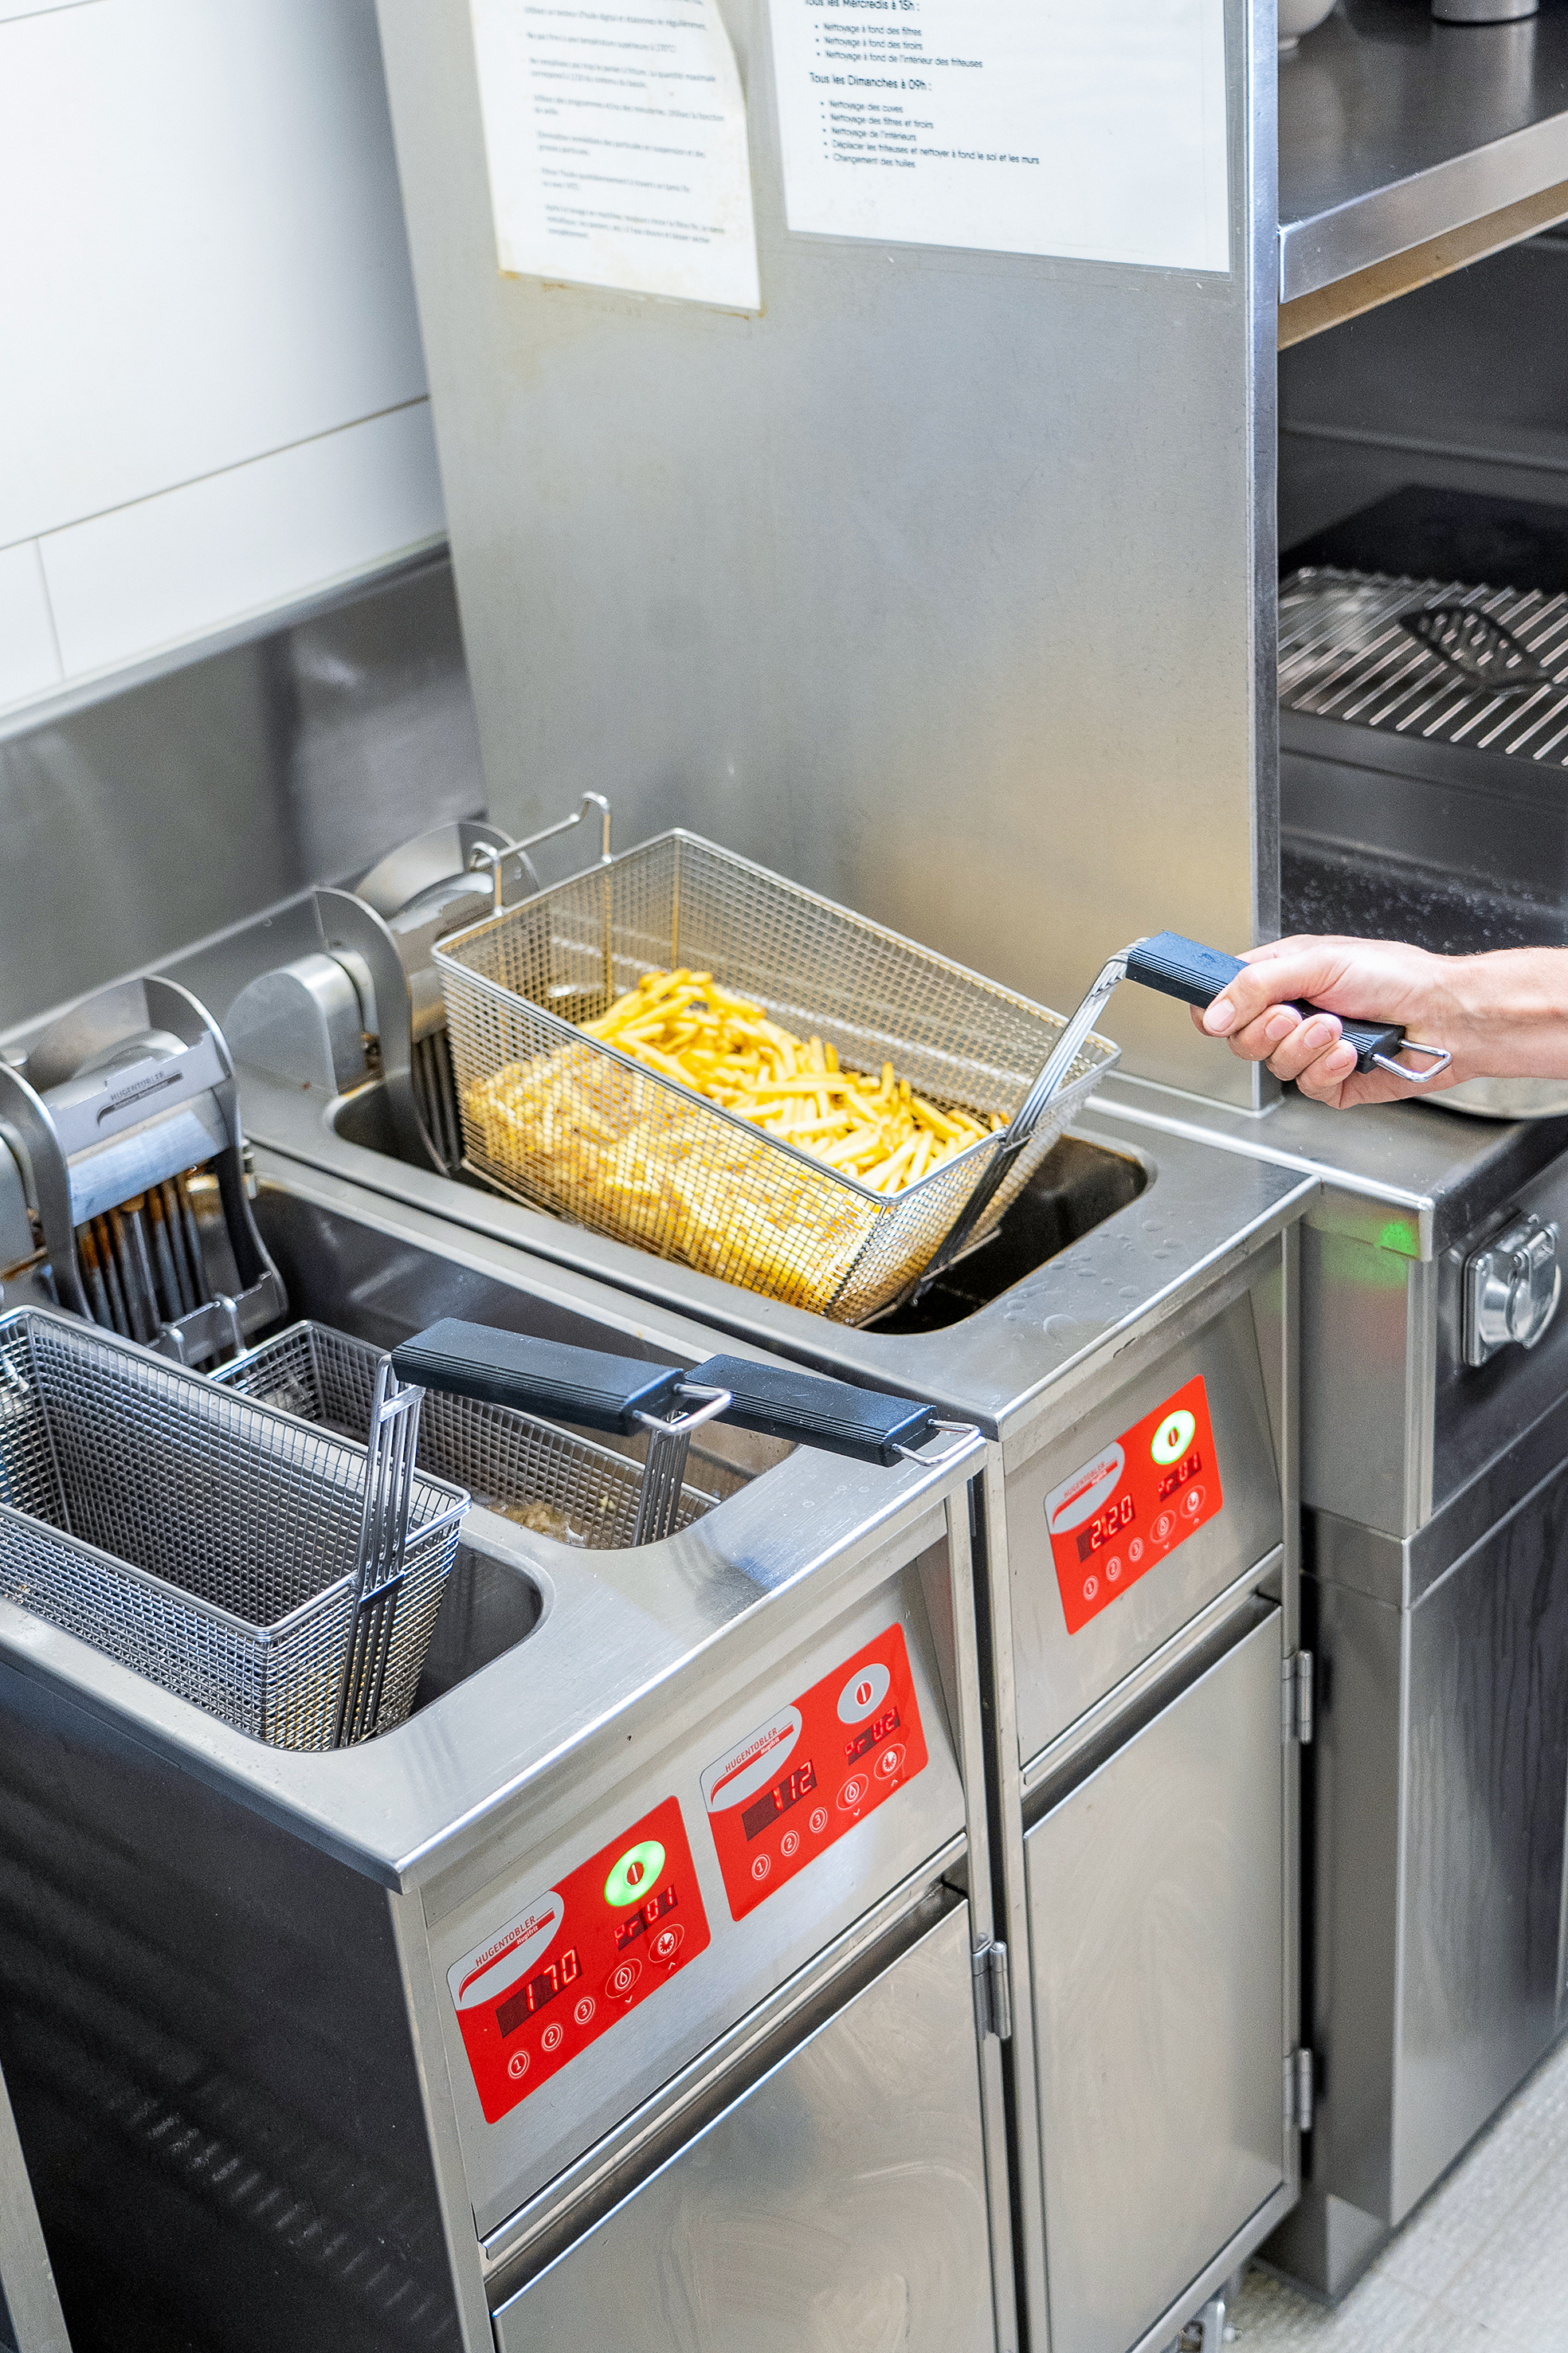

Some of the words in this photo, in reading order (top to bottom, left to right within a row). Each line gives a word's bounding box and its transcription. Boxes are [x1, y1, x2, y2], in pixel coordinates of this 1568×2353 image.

[824, 23, 860, 35] Nettoyage
[868, 25, 884, 34] fond
[888, 25, 900, 35] des
[903, 26, 922, 37] filtres
[824, 37, 860, 49] Nettoyage
[869, 38, 885, 48] fond
[888, 40, 900, 49] des
[904, 41, 923, 50] tiroirs
[825, 50, 861, 62] Nettoyage
[870, 53, 886, 62] fond
[888, 53, 898, 63] de
[935, 57, 948, 66] des
[951, 57, 983, 69] friteuses
[809, 73, 830, 84] Tous
[832, 74, 845, 85] les
[848, 75, 898, 88] Dimanches
[908, 80, 927, 91] 09h
[829, 100, 864, 112] Nettoyage
[868, 103, 880, 112] des
[830, 113, 866, 126] Nettoyage
[868, 116, 881, 125] des
[884, 117, 902, 127] filtres
[914, 120, 934, 129] tiroirs
[831, 127, 867, 139] Nettoyage
[833, 139, 864, 151] Déplacer
[867, 143, 876, 152] les
[879, 144, 908, 155] friteuses
[920, 147, 950, 159] nettoyer
[958, 149, 974, 159] fond
[986, 151, 997, 161] sol
[1009, 154, 1019, 163] les
[1022, 156, 1040, 165] murs
[833, 153, 878, 166] Changement
[880, 157, 893, 167] des
[725, 1727, 778, 1774] HUGENTOBLER
[475, 1915, 537, 1968] HUGENTOBLER
[516, 1924, 539, 1945] Hugifrit
[526, 1948, 578, 2012] 170
